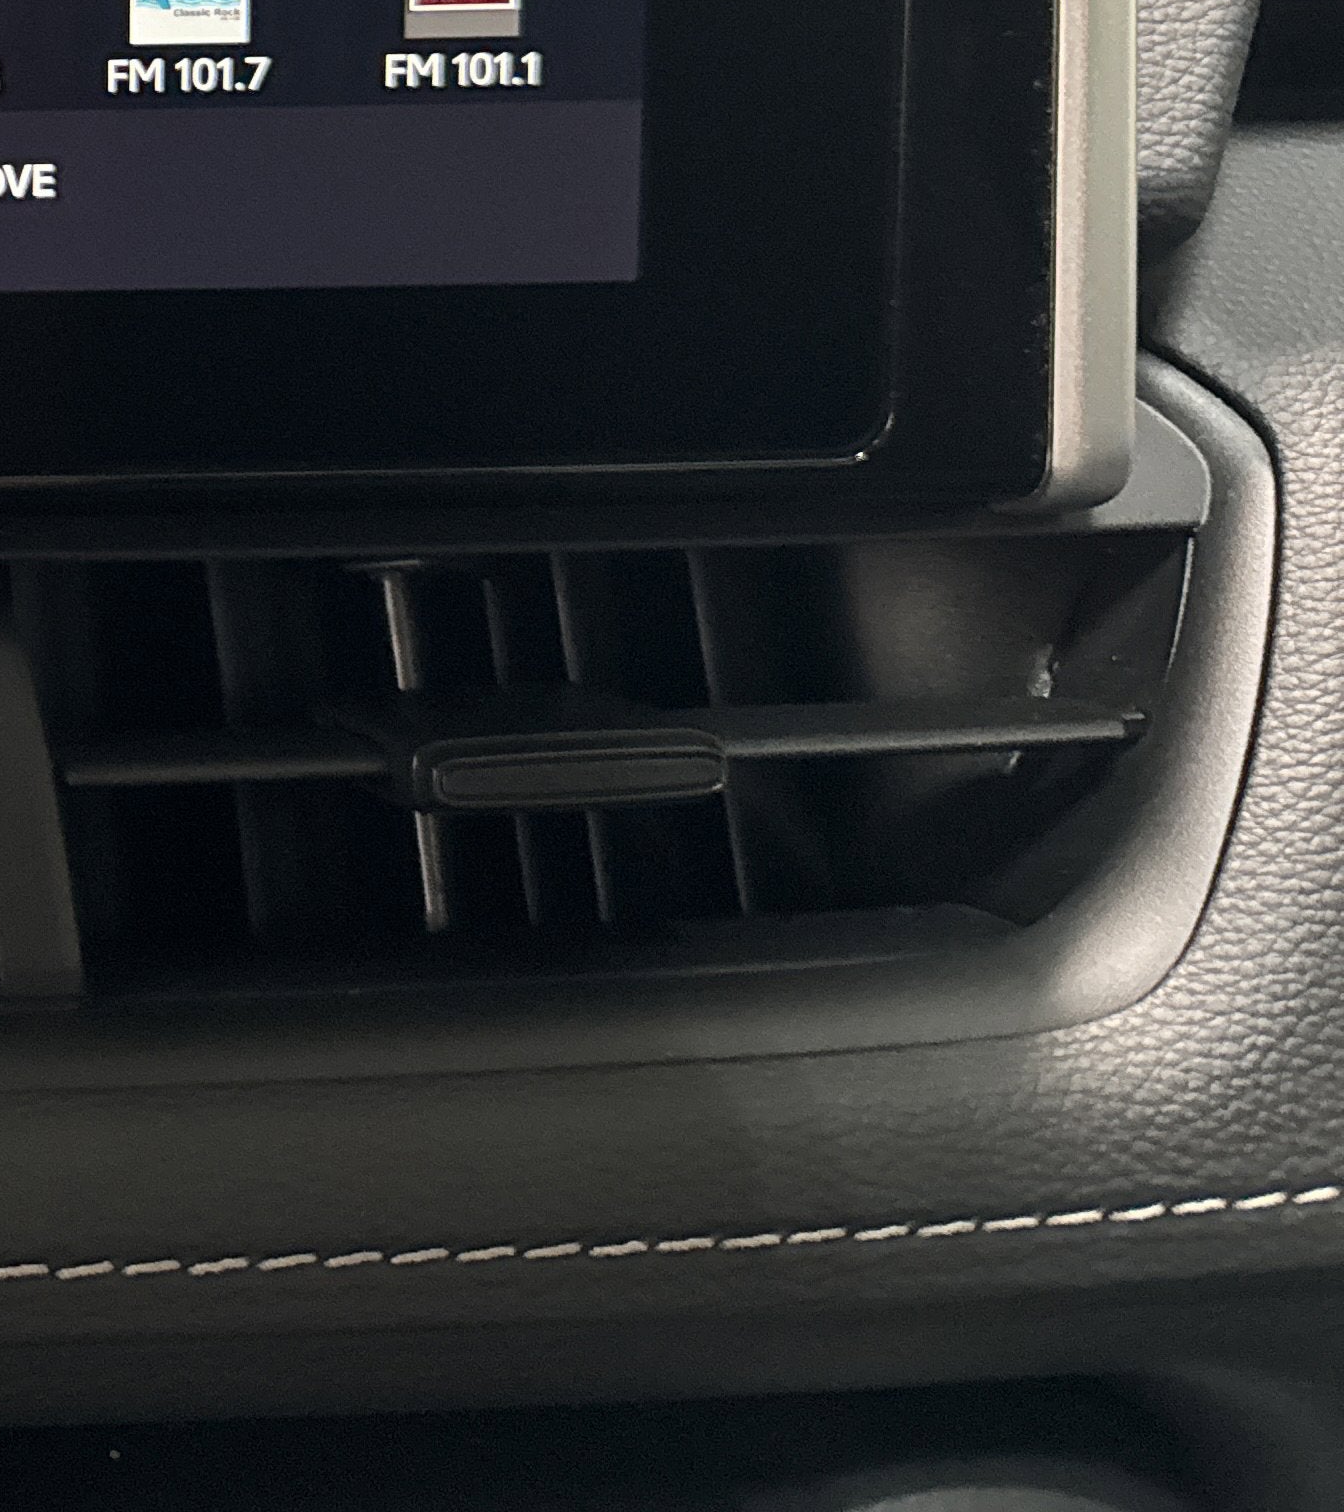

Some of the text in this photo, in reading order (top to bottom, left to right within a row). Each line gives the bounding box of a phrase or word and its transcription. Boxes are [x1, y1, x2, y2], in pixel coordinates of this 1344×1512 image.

[107, 56, 272, 93] FM 101.7
[384, 51, 541, 88] FM 101.1
